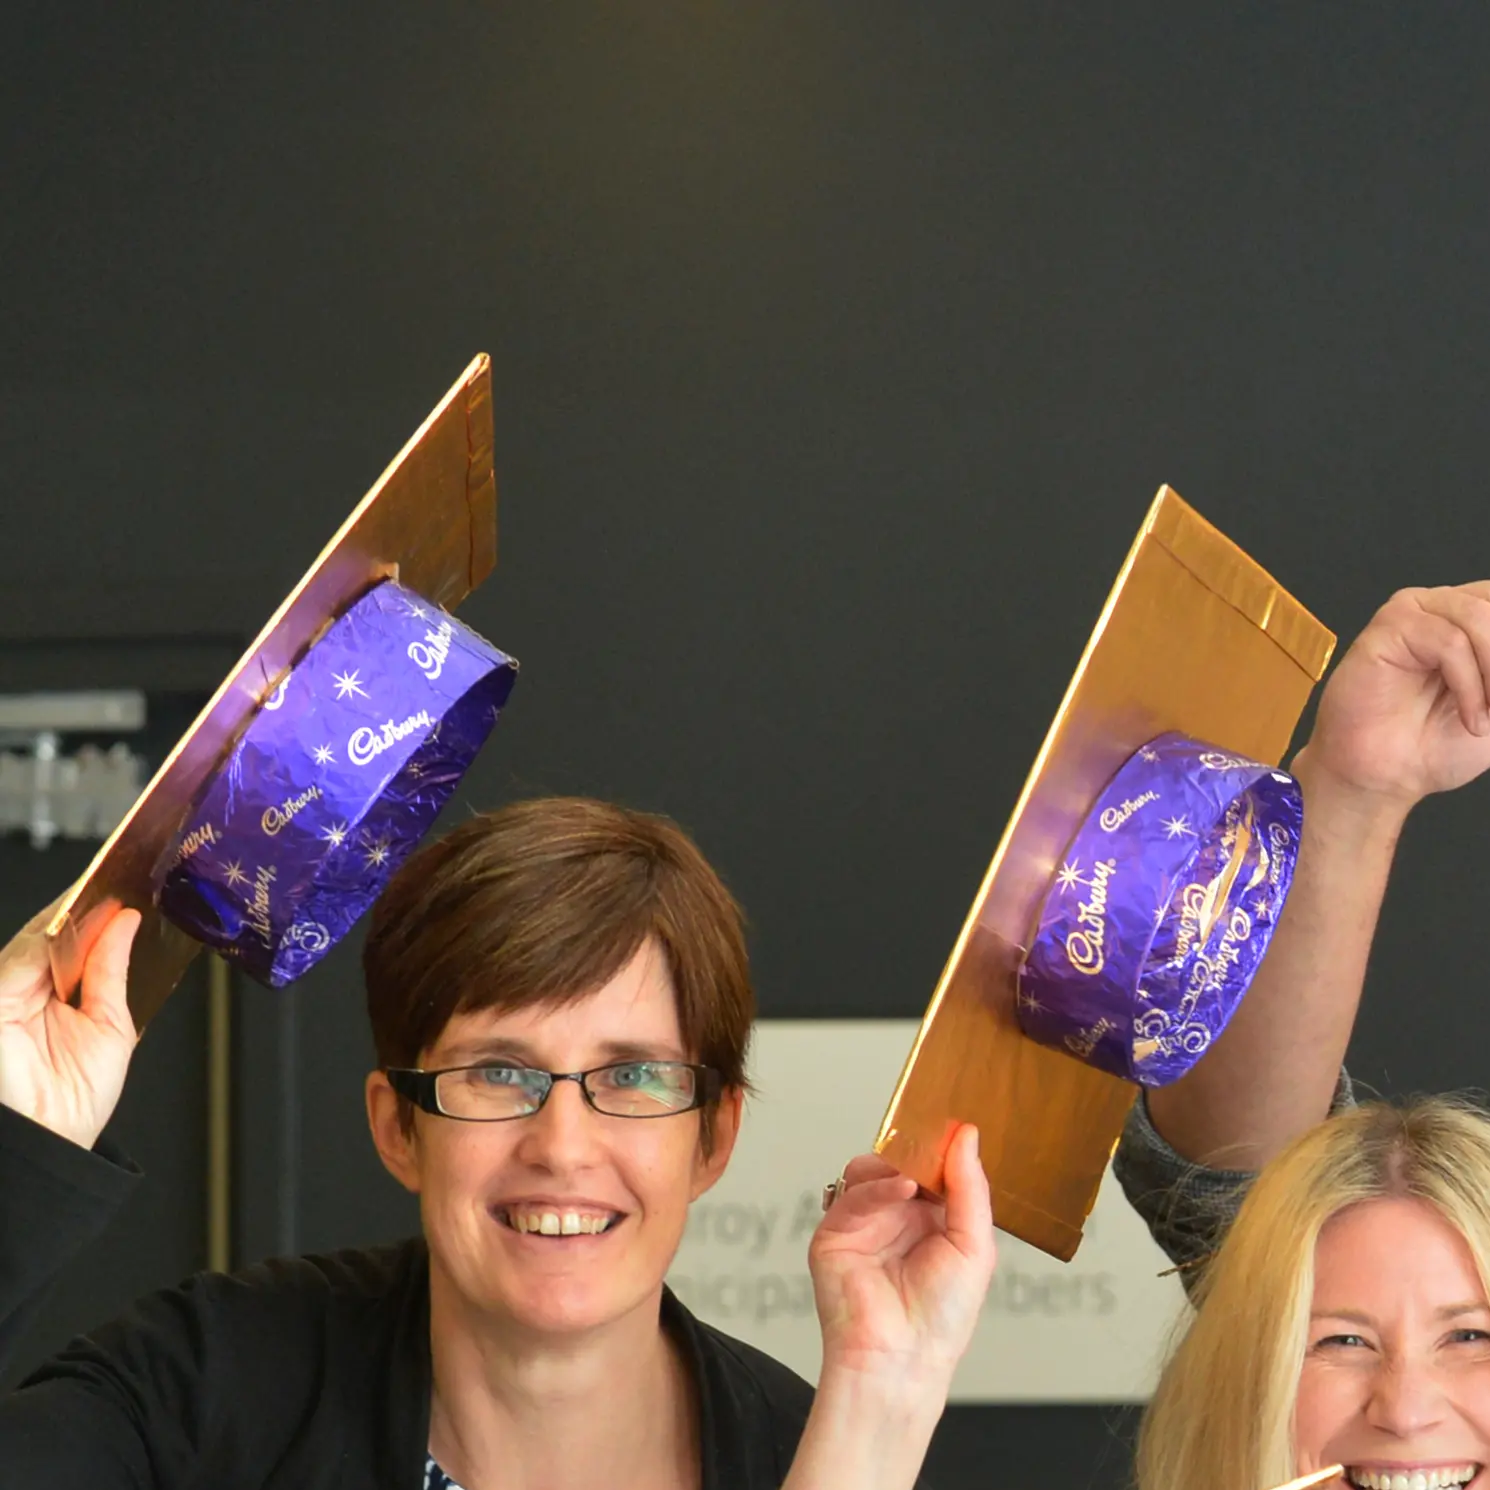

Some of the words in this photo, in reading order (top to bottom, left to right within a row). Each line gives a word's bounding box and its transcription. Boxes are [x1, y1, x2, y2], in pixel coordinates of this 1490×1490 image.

[347, 709, 432, 766] Cadbury
[261, 785, 320, 836] Cadbury
[1100, 789, 1156, 832] Cadbury
[1067, 860, 1116, 975] Cadbury
